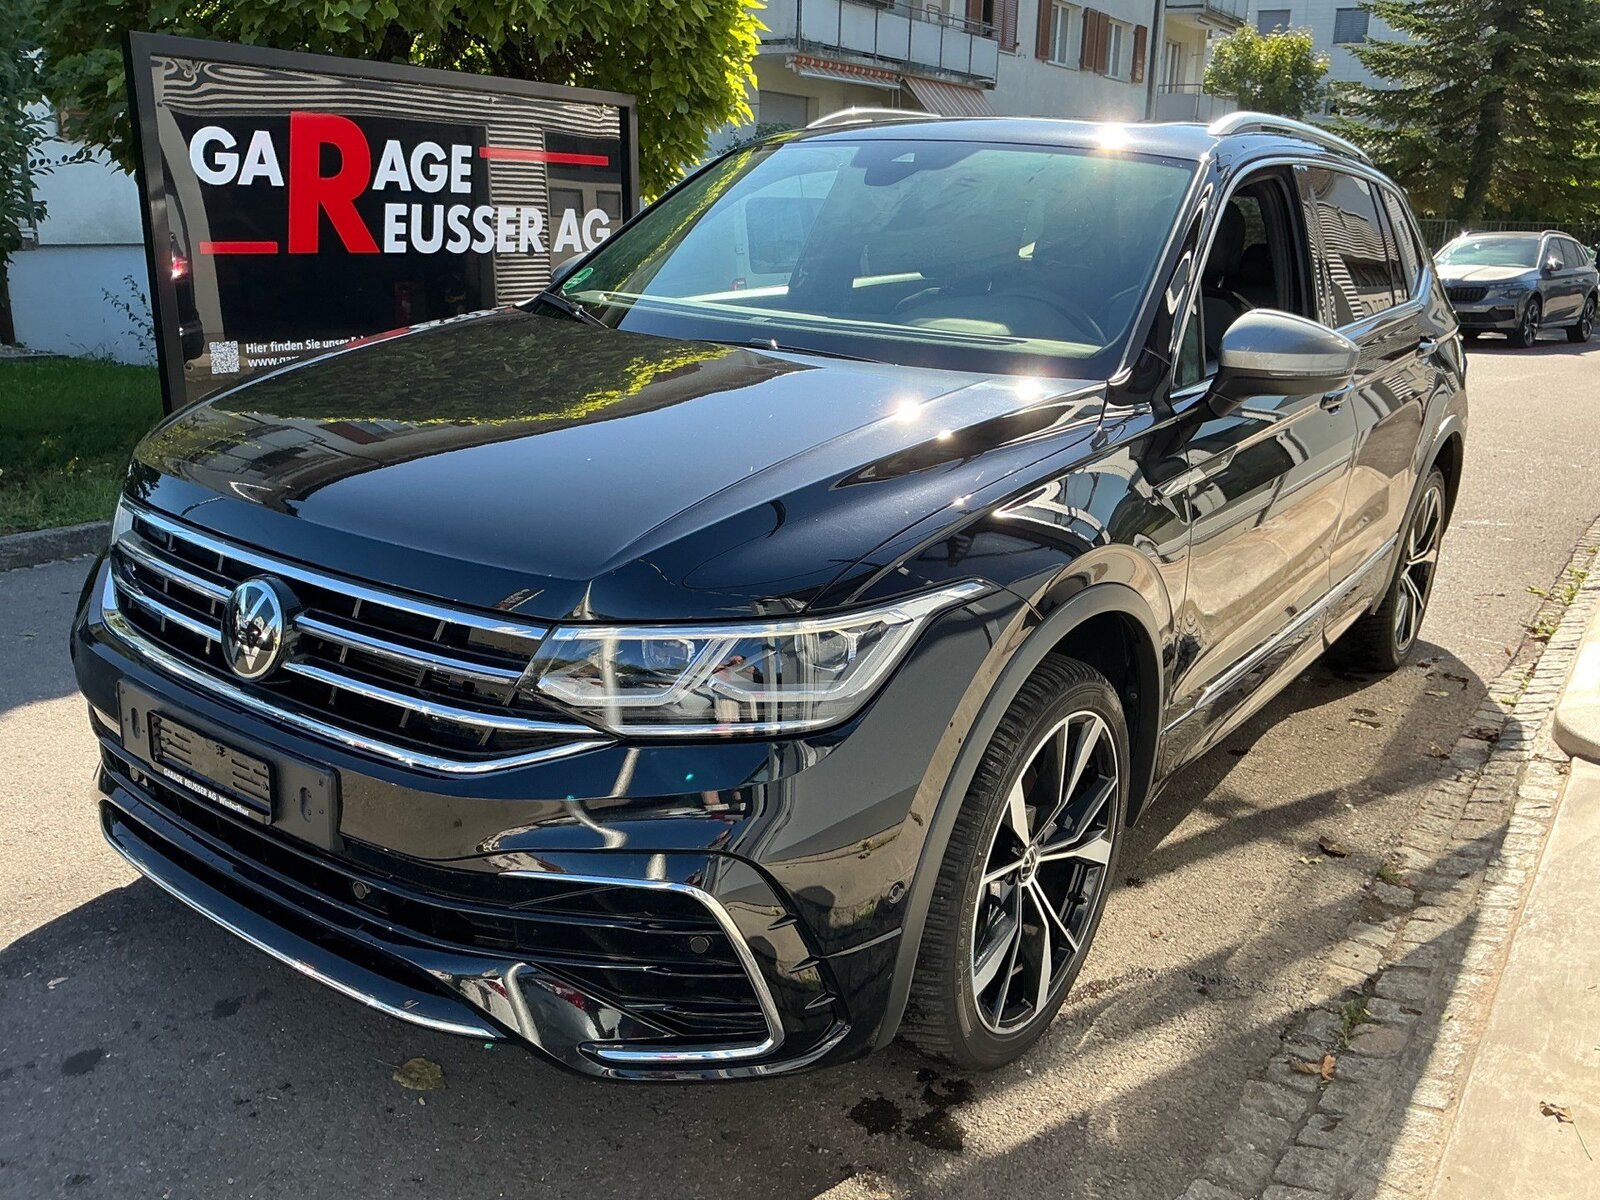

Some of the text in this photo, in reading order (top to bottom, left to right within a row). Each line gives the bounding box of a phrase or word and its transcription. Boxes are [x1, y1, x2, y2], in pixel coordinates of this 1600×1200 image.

[553, 208, 611, 253] AG
[246, 343, 268, 354] Hier
[270, 340, 303, 352] finden
[306, 339, 320, 350] Sie
[208, 790, 217, 801] AG
